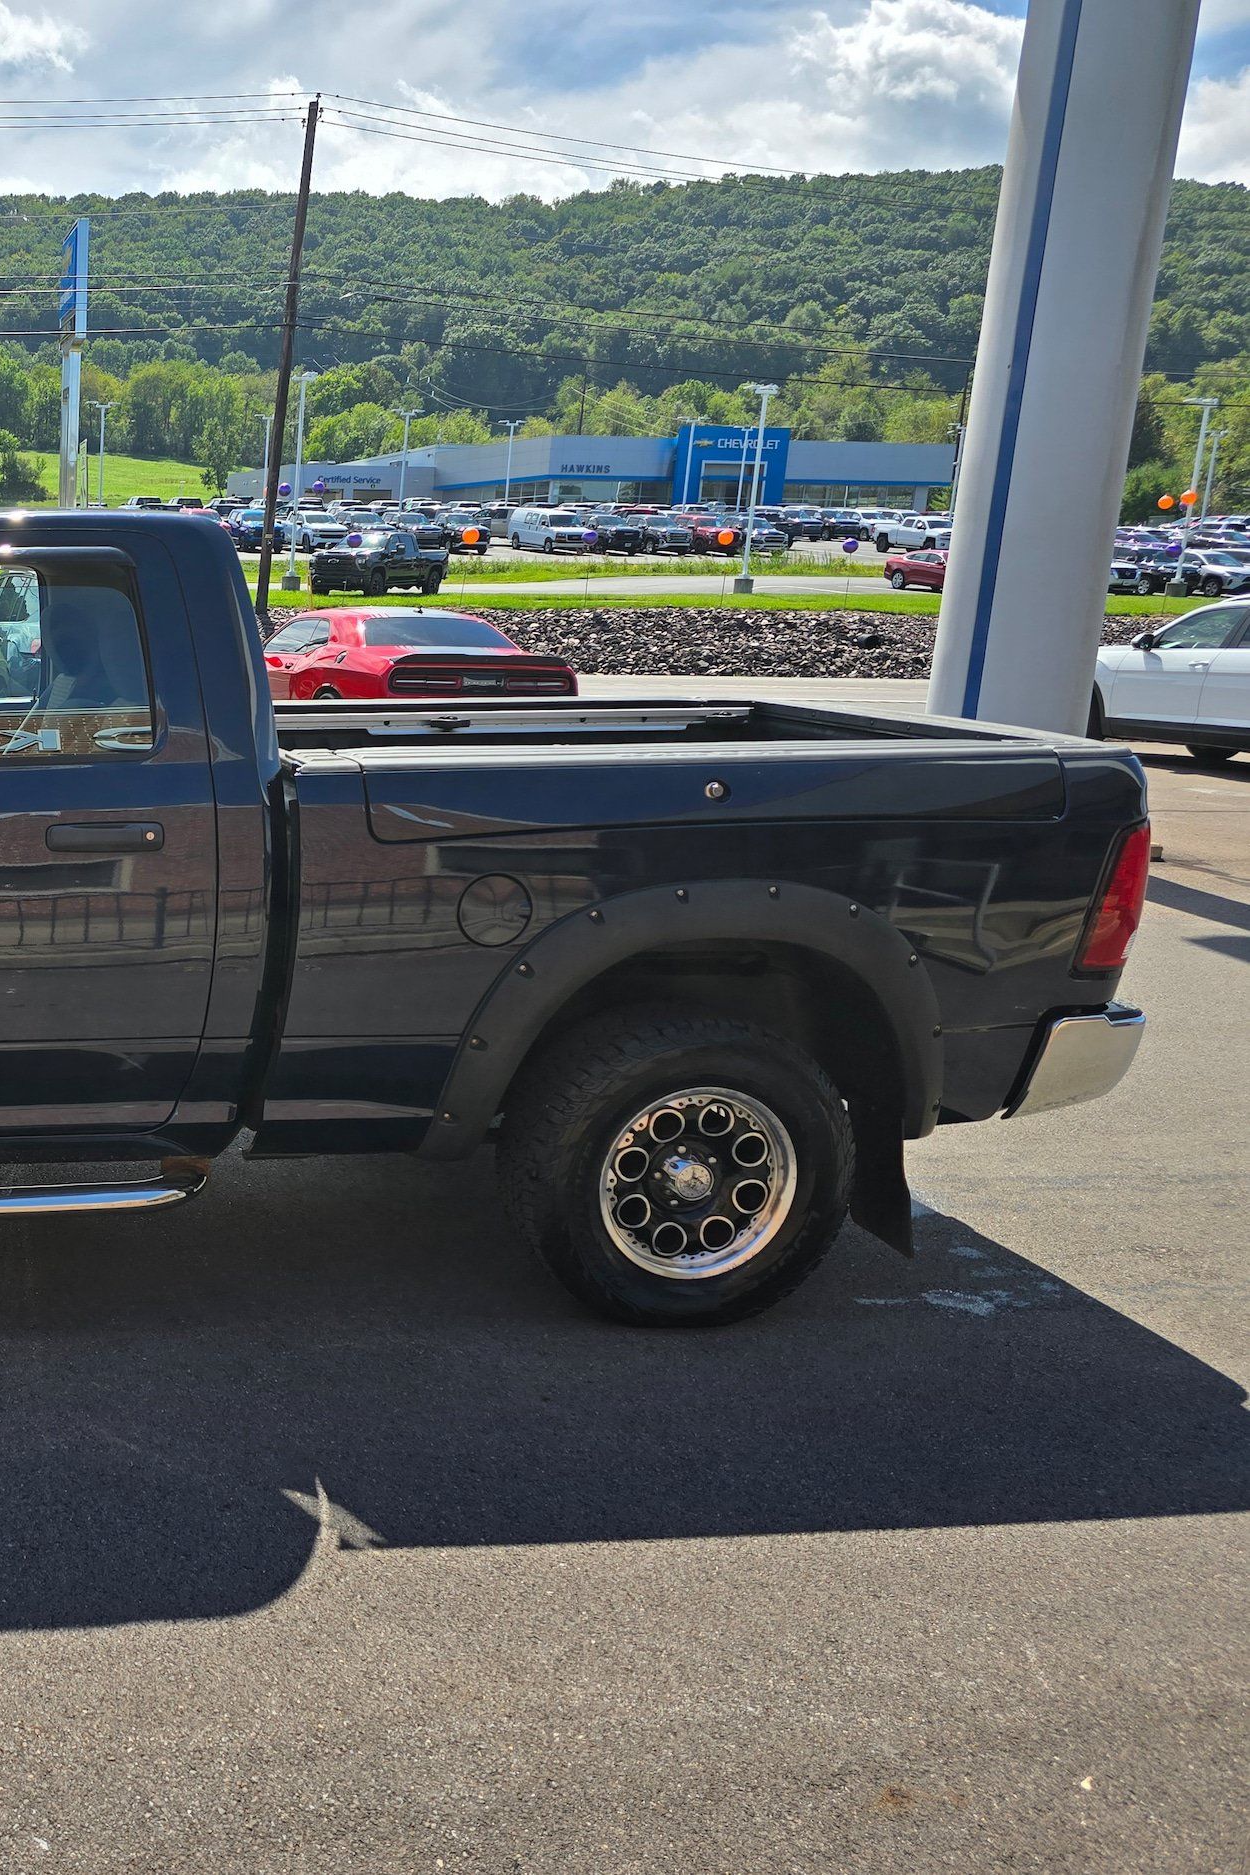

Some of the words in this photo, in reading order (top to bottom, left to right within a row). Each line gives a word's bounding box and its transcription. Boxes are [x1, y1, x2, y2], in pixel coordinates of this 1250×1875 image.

[560, 463, 611, 474] HAWKINS
[317, 475, 351, 484] Certified
[353, 475, 381, 484] Service
